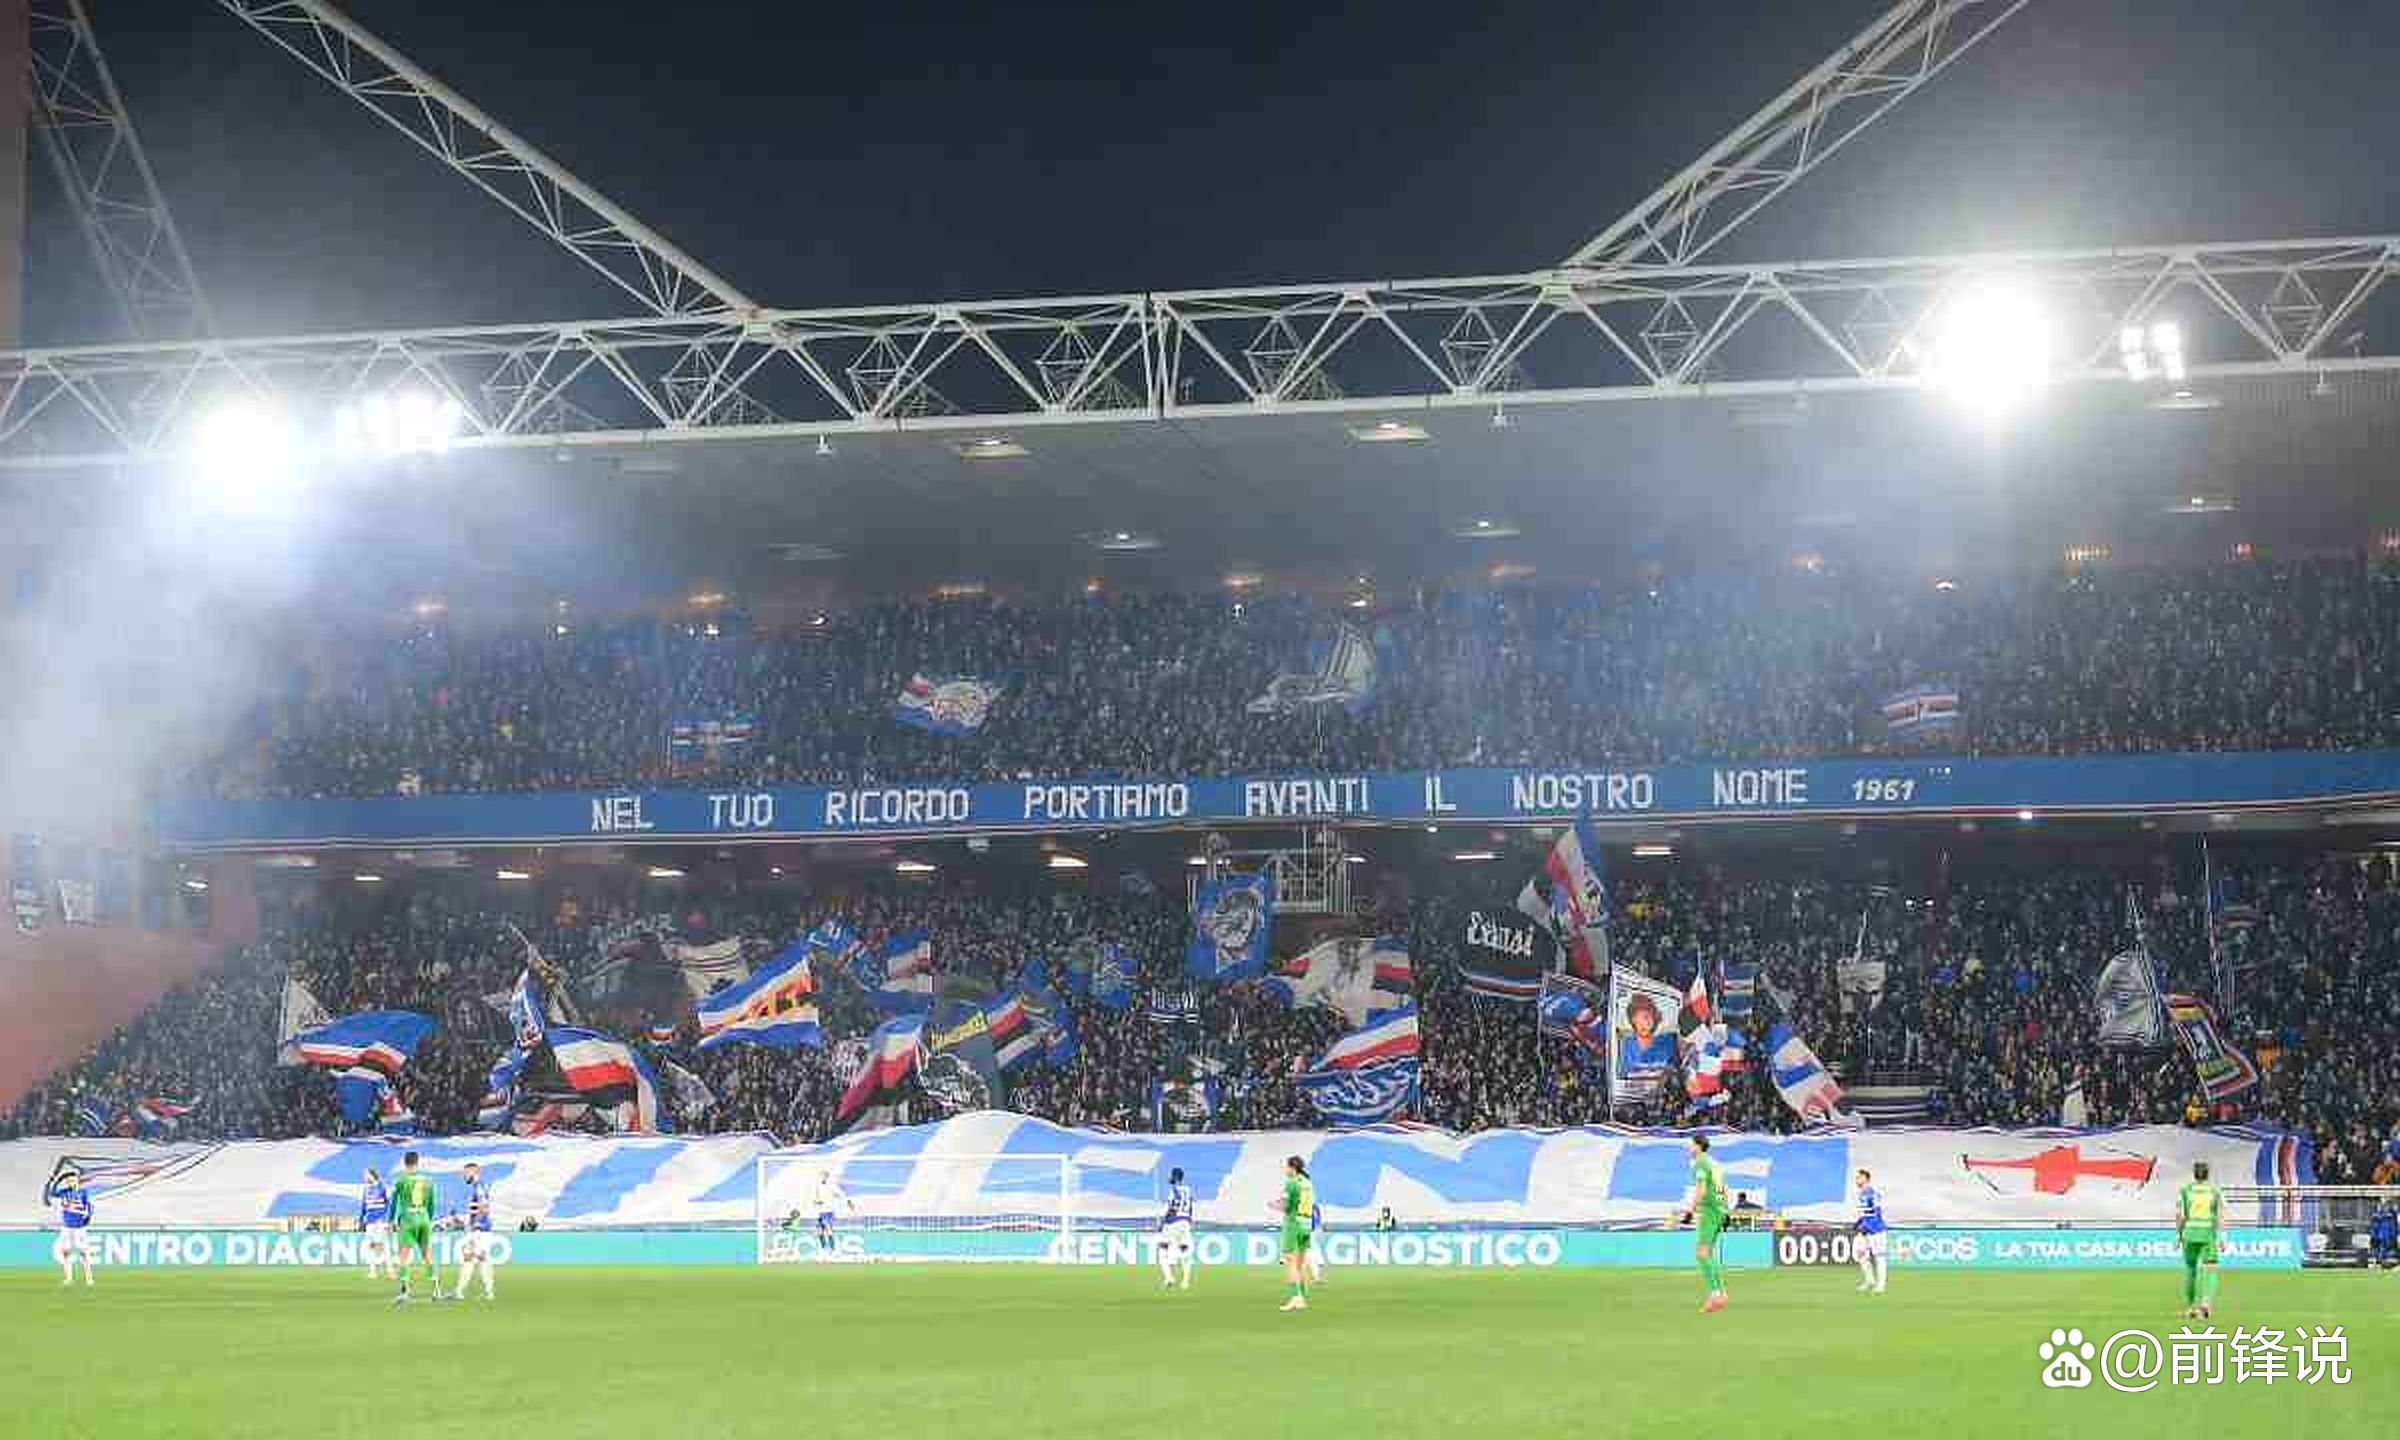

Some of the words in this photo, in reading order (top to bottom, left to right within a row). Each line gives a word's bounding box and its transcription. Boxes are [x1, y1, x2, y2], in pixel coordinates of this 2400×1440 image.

[591, 795, 654, 832] NEL
[708, 794, 773, 829] TUO
[825, 788, 970, 825] RICORDO
[1023, 784, 1188, 820] PORTIAMO
[1244, 779, 1369, 817] AVANTI
[1424, 776, 1458, 813] IL
[1512, 773, 1655, 811] NOSTRO
[1712, 768, 1808, 807] NOME
[1246, 1232, 1563, 1265] DAGNOSTICO
